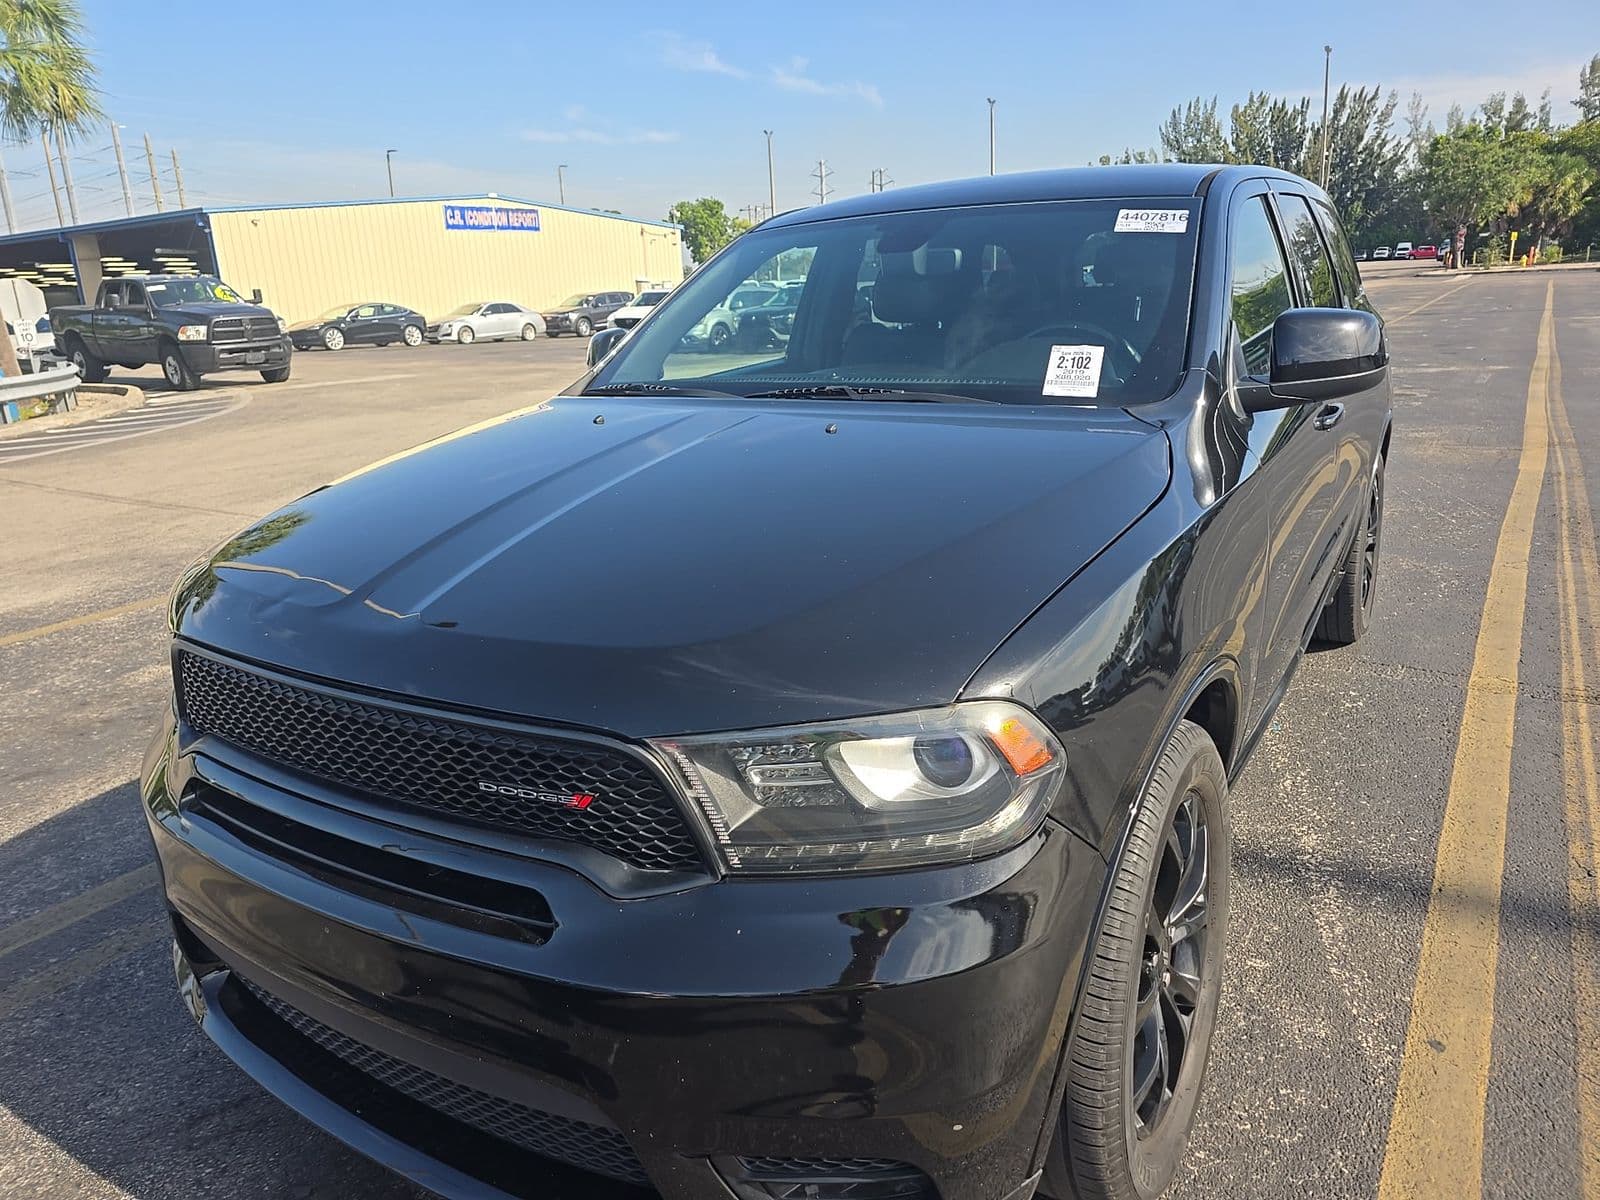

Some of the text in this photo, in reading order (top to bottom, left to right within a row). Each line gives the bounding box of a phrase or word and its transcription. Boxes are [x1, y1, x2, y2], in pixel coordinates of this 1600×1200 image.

[1121, 212, 1189, 222] 4407816
[21, 333, 34, 342] 10
[1057, 356, 1092, 370] 2:102
[479, 782, 578, 805] DODGE
